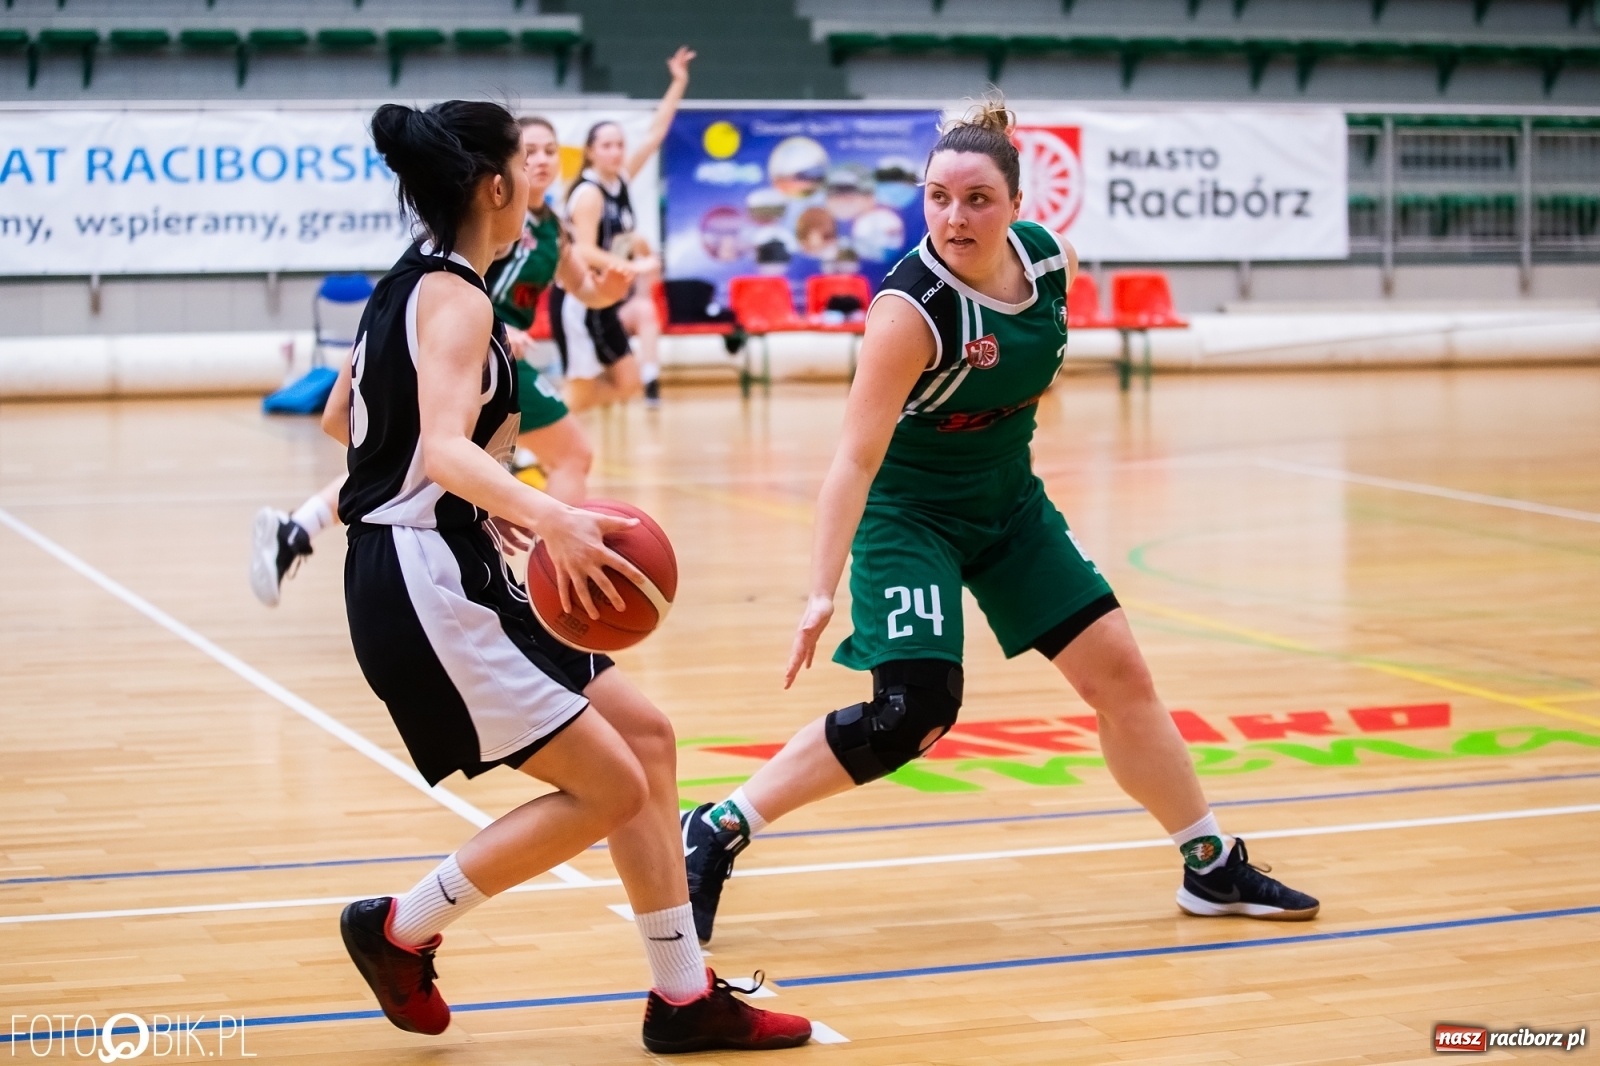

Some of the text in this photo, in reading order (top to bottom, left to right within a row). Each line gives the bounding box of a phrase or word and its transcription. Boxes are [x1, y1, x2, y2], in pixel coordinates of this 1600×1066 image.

[1108, 149, 1219, 170] MIASTO
[1108, 174, 1312, 218] Racibórz
[75, 206, 288, 244] wspieramy,
[921, 279, 945, 304] COLO
[884, 584, 944, 639] 24
